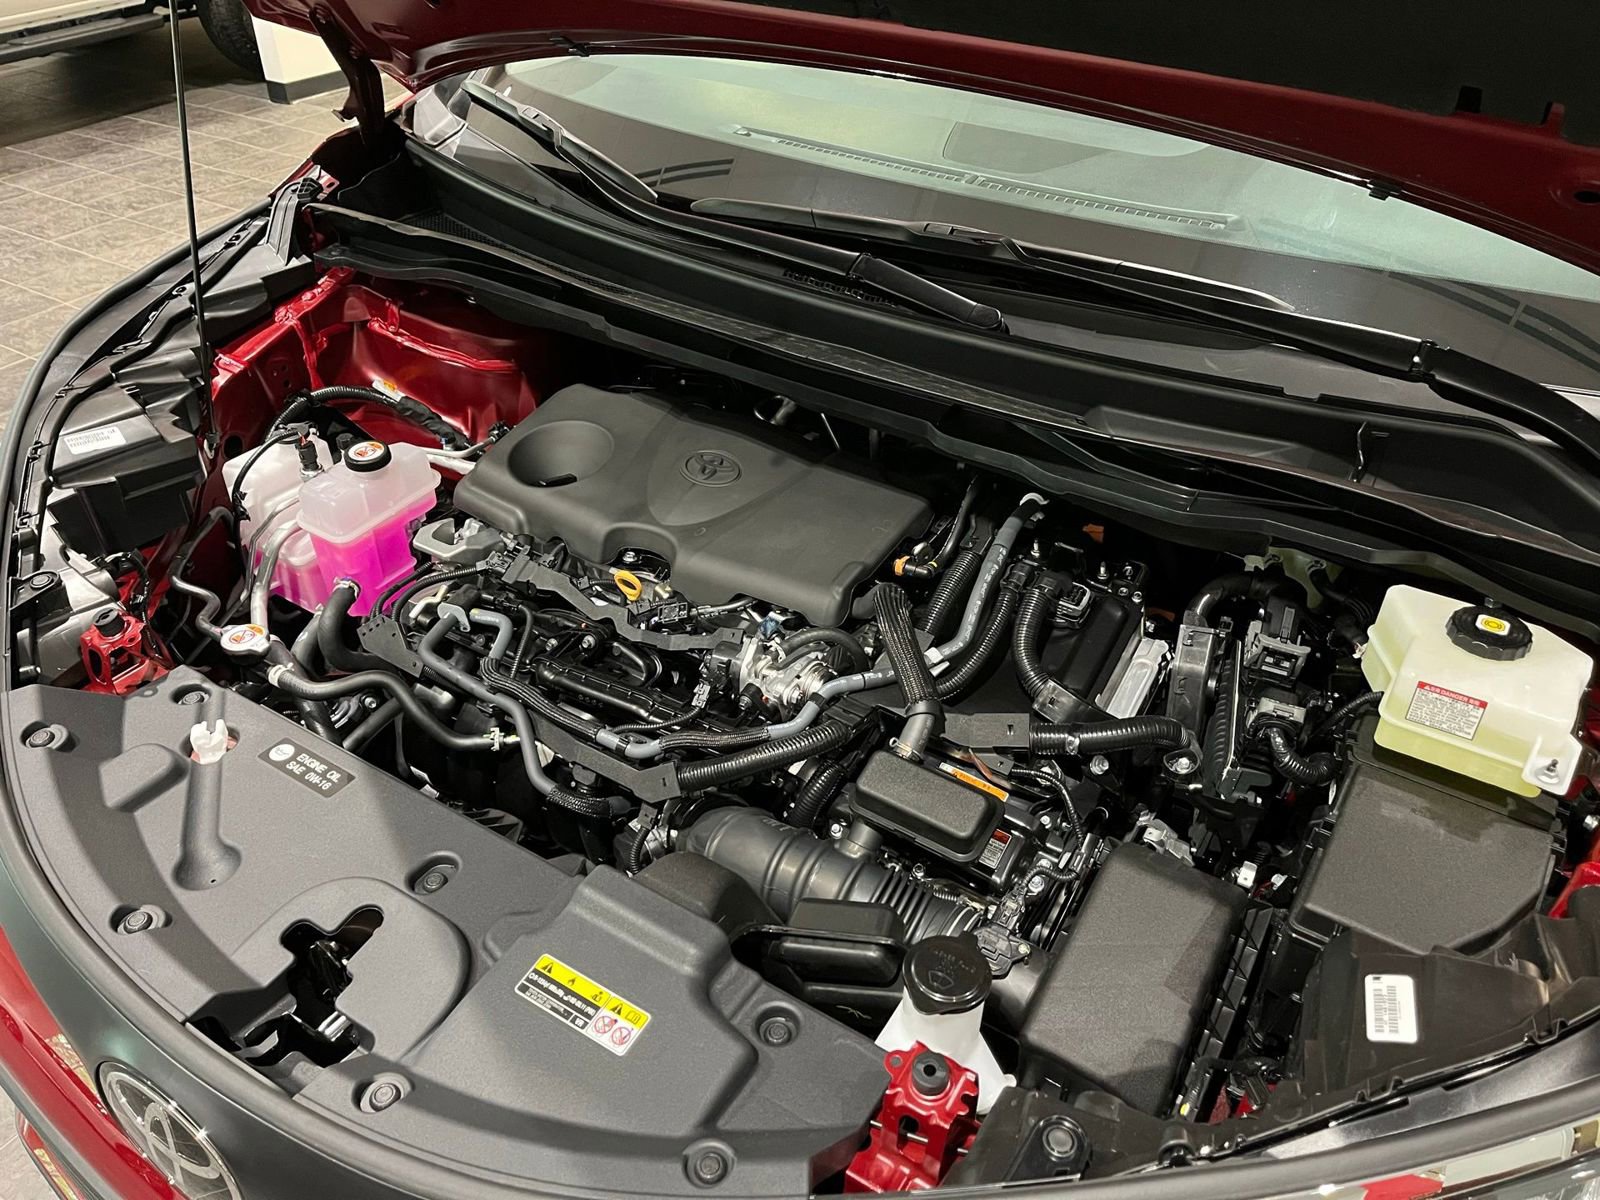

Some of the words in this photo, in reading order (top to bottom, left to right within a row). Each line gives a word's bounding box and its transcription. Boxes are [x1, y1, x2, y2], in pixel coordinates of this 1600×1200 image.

[1440, 689, 1469, 702] DANGER
[285, 761, 306, 775] SAE
[304, 772, 332, 790] 0W-16
[296, 753, 328, 773] ENGINE
[326, 770, 341, 783] OIL
